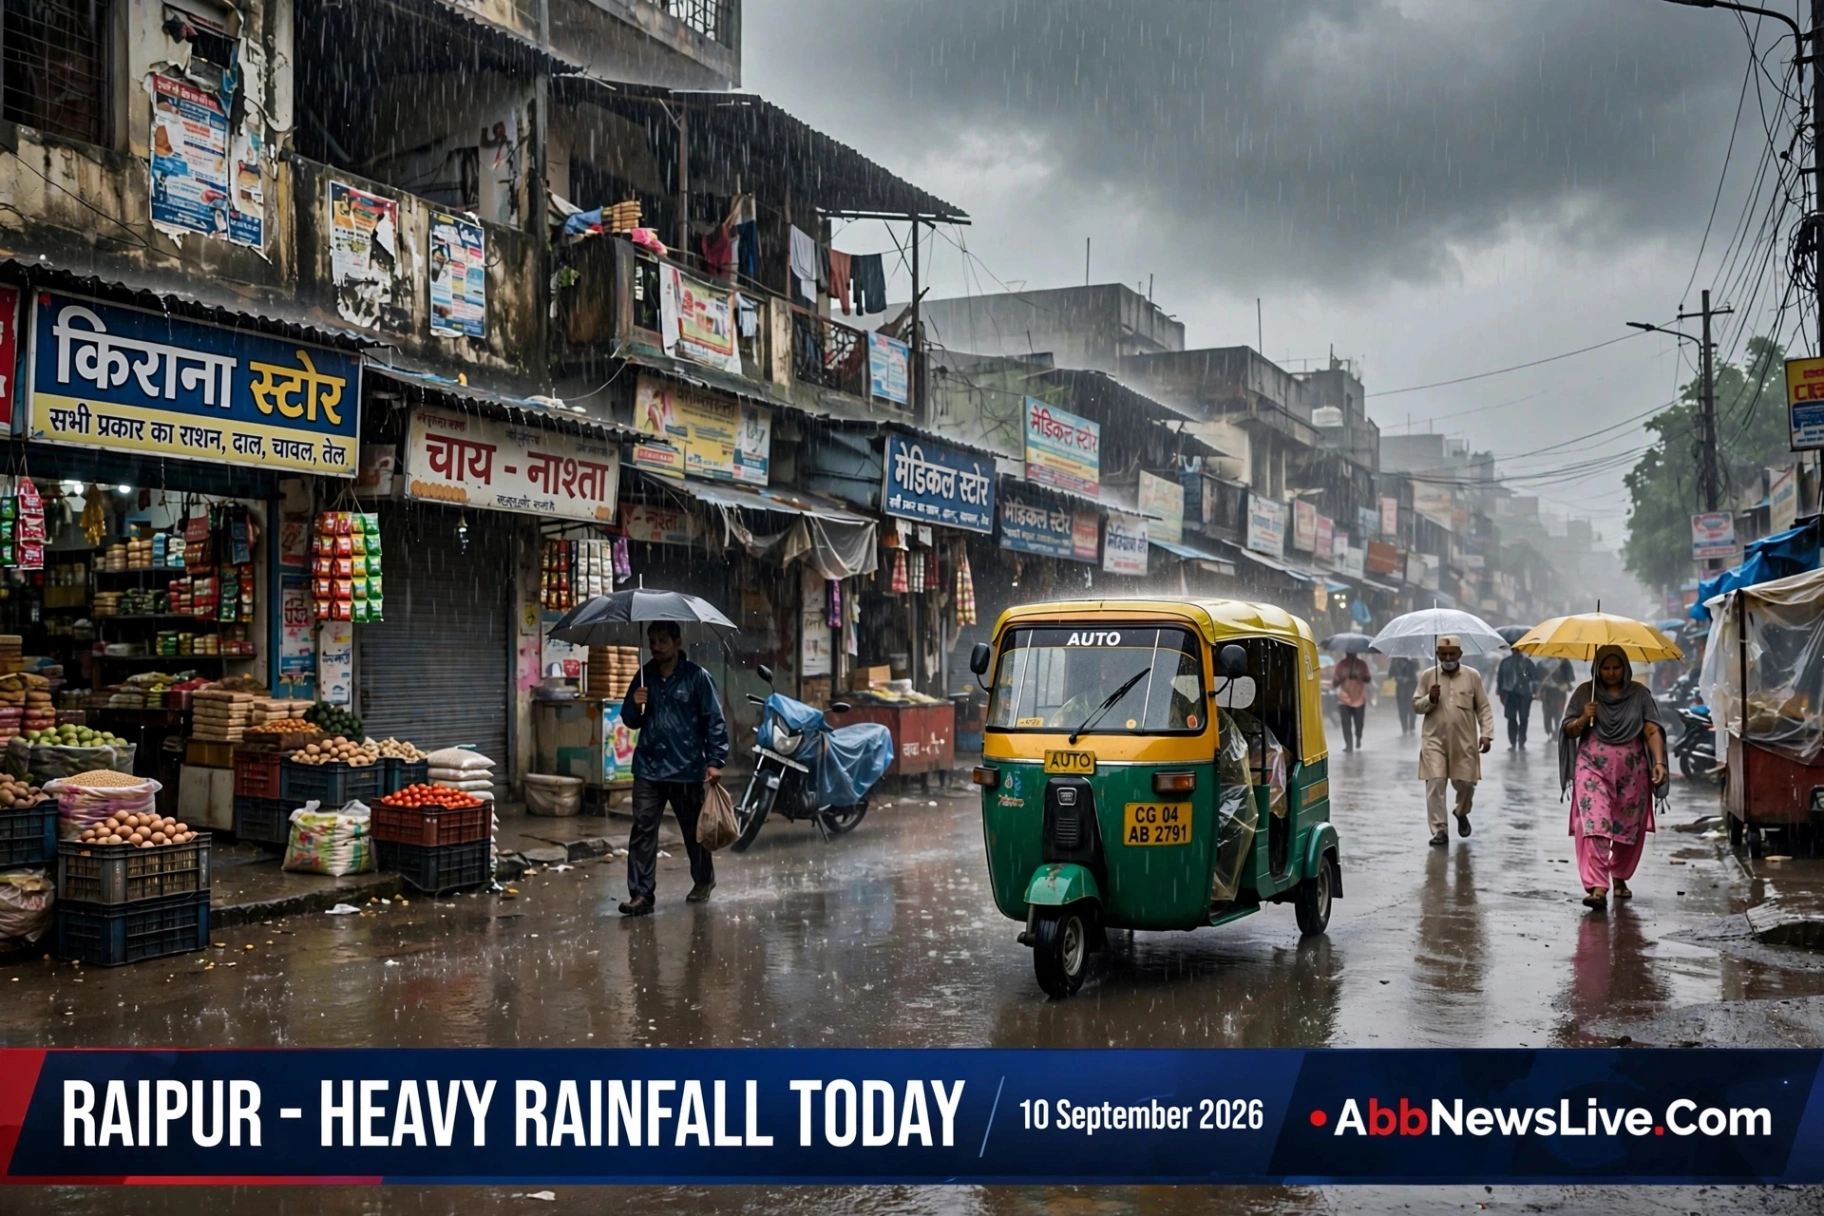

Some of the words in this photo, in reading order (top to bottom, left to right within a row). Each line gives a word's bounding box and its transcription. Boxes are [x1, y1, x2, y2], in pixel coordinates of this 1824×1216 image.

[53, 305, 237, 408] किराना
[249, 350, 347, 425] स्टोर
[49, 402, 92, 434] सभी
[97, 414, 145, 441] प्रकार
[151, 421, 175, 444] का
[179, 425, 226, 455] राशन,
[232, 432, 266, 459] दाल,
[271, 438, 317, 466] चावल,
[425, 432, 497, 485] चाय
[527, 450, 609, 502] नाश्ता
[895, 441, 958, 499] मेडिकल
[959, 462, 990, 506] स्टोर
[1004, 494, 1048, 530] मेडिकल
[1066, 631, 1121, 646] AUTO
[1049, 752, 1091, 769] AUTO
[1135, 806, 1157, 823] CG
[1162, 806, 1178, 823] 04
[1128, 826, 1150, 843] AB
[1154, 824, 1187, 843] 2791
